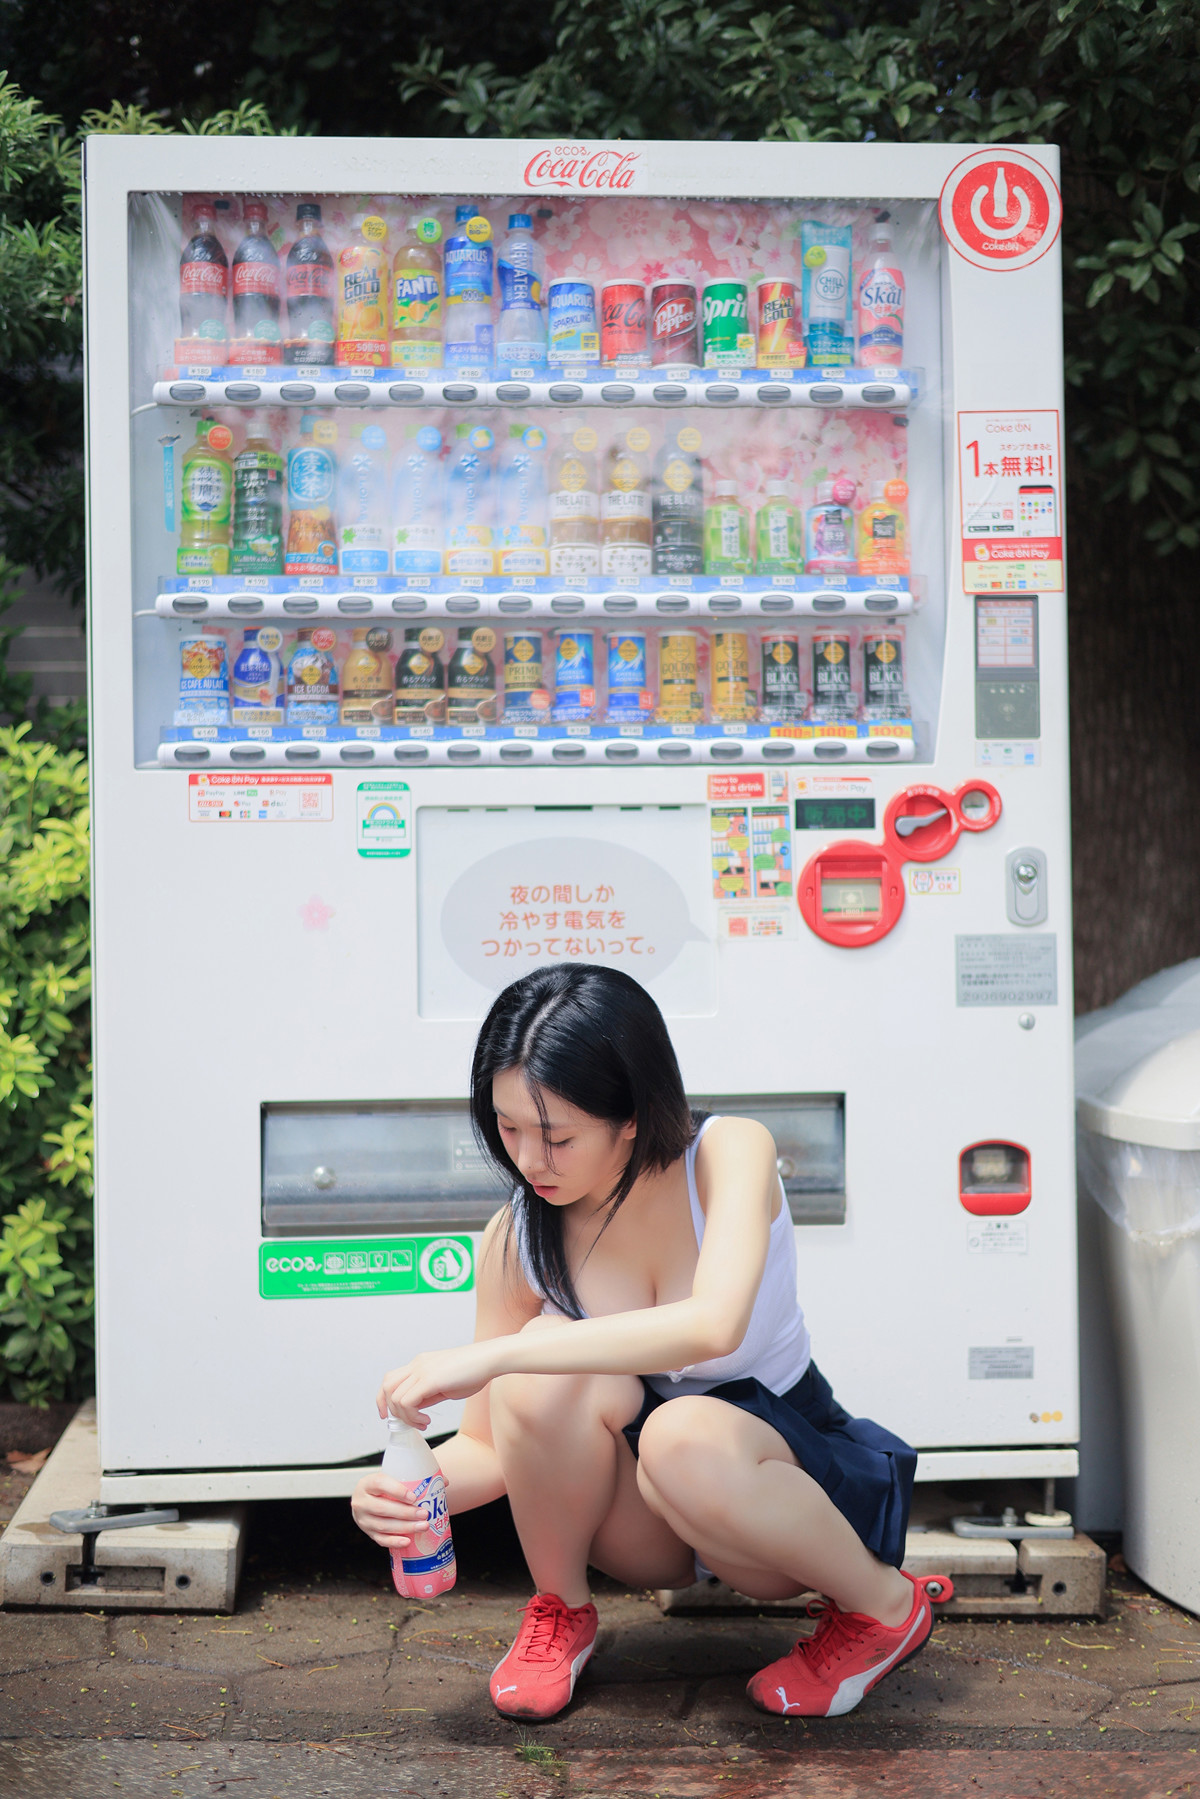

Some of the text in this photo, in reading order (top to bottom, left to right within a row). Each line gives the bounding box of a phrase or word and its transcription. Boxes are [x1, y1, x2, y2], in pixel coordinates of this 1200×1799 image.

[524, 150, 643, 188] Coca-Cola
[445, 249, 488, 264] AQUARIUS
[182, 265, 223, 283] Coca-Cola
[235, 265, 276, 283] Coca-Cola
[344, 267, 380, 286] REAL
[819, 276, 844, 287] CHILL
[344, 283, 380, 300] GOLD
[396, 276, 440, 298] FANTA
[823, 285, 840, 294] OUT
[667, 303, 686, 318] Dr
[764, 293, 793, 313] REAL
[656, 310, 696, 337] Pepper
[764, 307, 793, 325] GOLD
[344, 352, 373, 361] ビタミンC
[986, 423, 1031, 433] Coke ON
[301, 453, 322, 497] 麦茶
[991, 549, 1014, 559] Coke
[1031, 549, 1050, 560] Pay
[766, 672, 799, 684] BLACK
[817, 672, 850, 684] BLACK
[869, 672, 903, 684] BLACK
[294, 685, 330, 694] ICE COCOA
[211, 776, 231, 784] Coke
[231, 776, 243, 784] ON
[244, 776, 260, 785] Pay
[738, 783, 762, 792] drink
[850, 784, 867, 793] Pay
[804, 804, 867, 825] 販売中
[938, 882, 952, 891] OK
[510, 884, 615, 905] 夜の間しか
[499, 910, 626, 931] 冷やす電気を
[481, 936, 656, 957] つかってないって。
